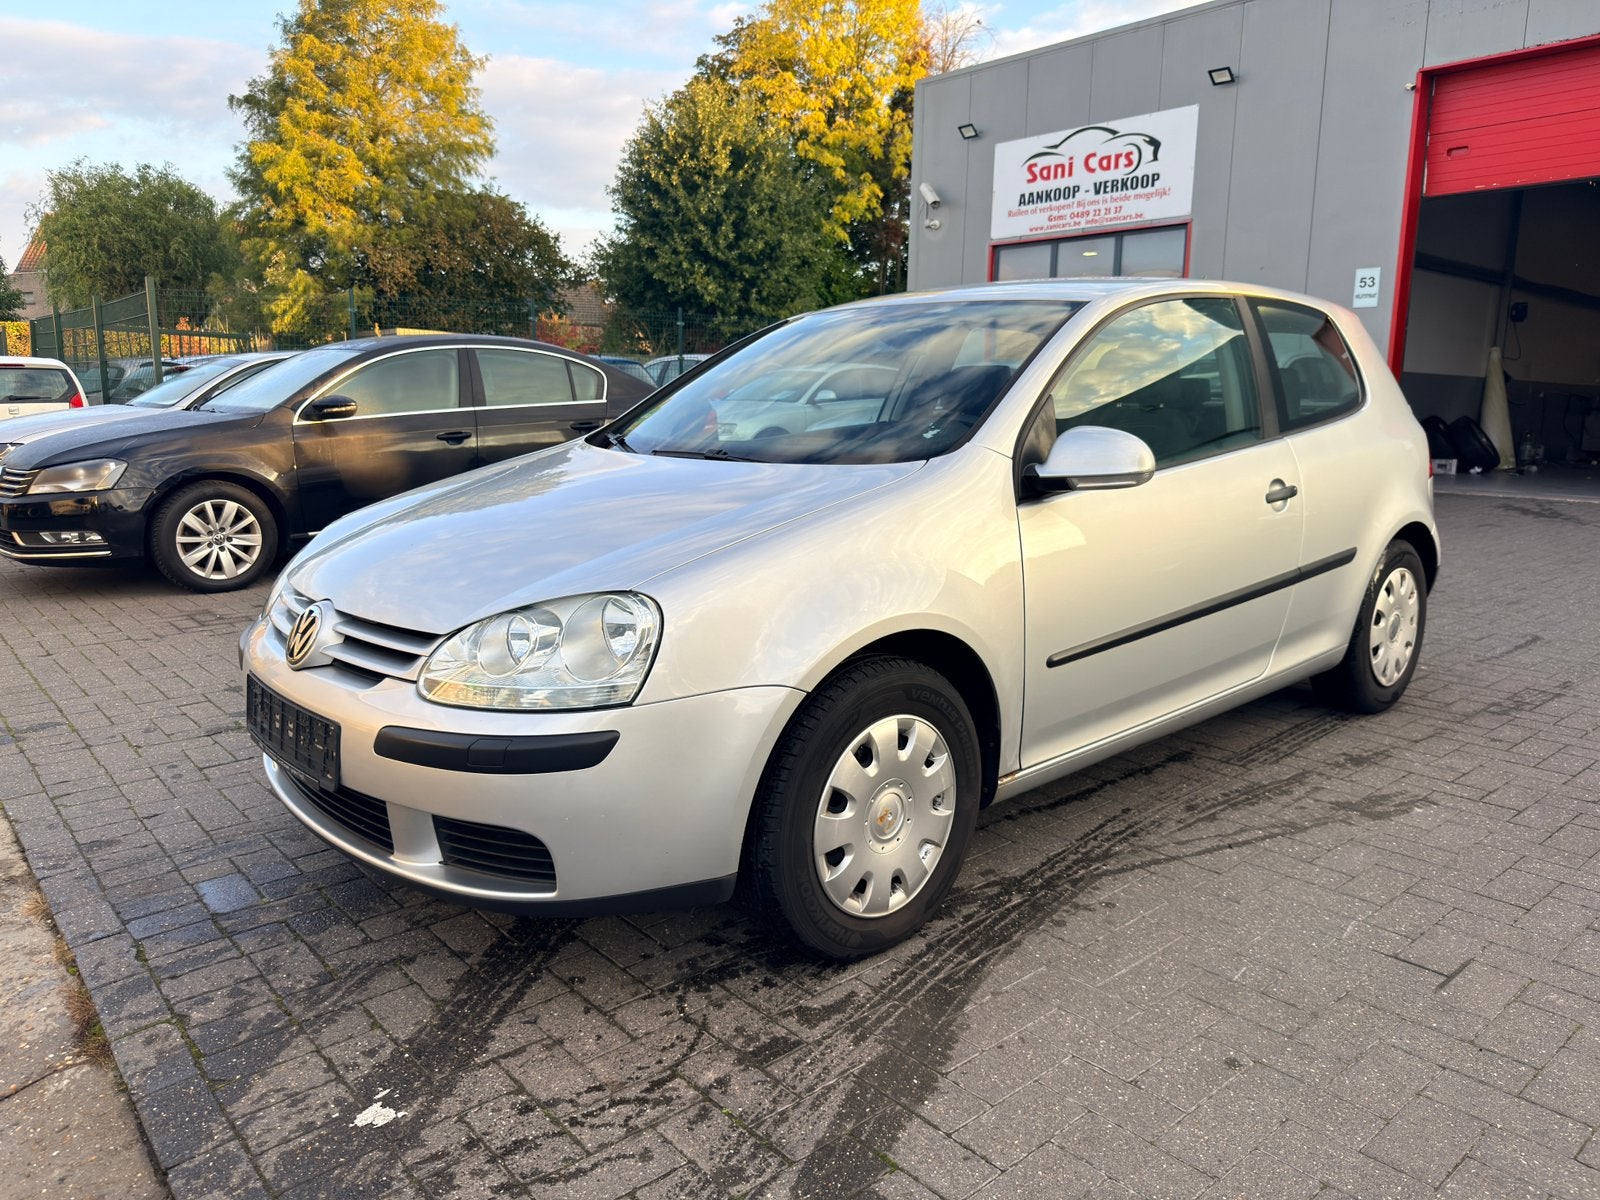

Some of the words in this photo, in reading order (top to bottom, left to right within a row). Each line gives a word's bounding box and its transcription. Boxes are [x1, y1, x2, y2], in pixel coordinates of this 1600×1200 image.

[1026, 156, 1074, 184] Sani
[1083, 151, 1135, 174] Cars
[1018, 185, 1081, 207] AANKOOP
[1093, 172, 1160, 196] VERKOOP
[1007, 207, 1029, 218] Ruilen
[1030, 206, 1038, 215] of
[1076, 199, 1086, 209] Bij
[1086, 199, 1100, 207] ons
[1101, 196, 1108, 205] is
[1109, 193, 1131, 204] beide
[1133, 187, 1171, 201] mogelijk!
[1047, 213, 1067, 223] Gsm:
[1069, 210, 1091, 220] 0489
[1092, 208, 1102, 217] 22
[1103, 206, 1112, 216] 21
[1113, 205, 1123, 214] 37
[1029, 218, 1081, 233] www.sanicars.be
[1359, 276, 1376, 288] 53
